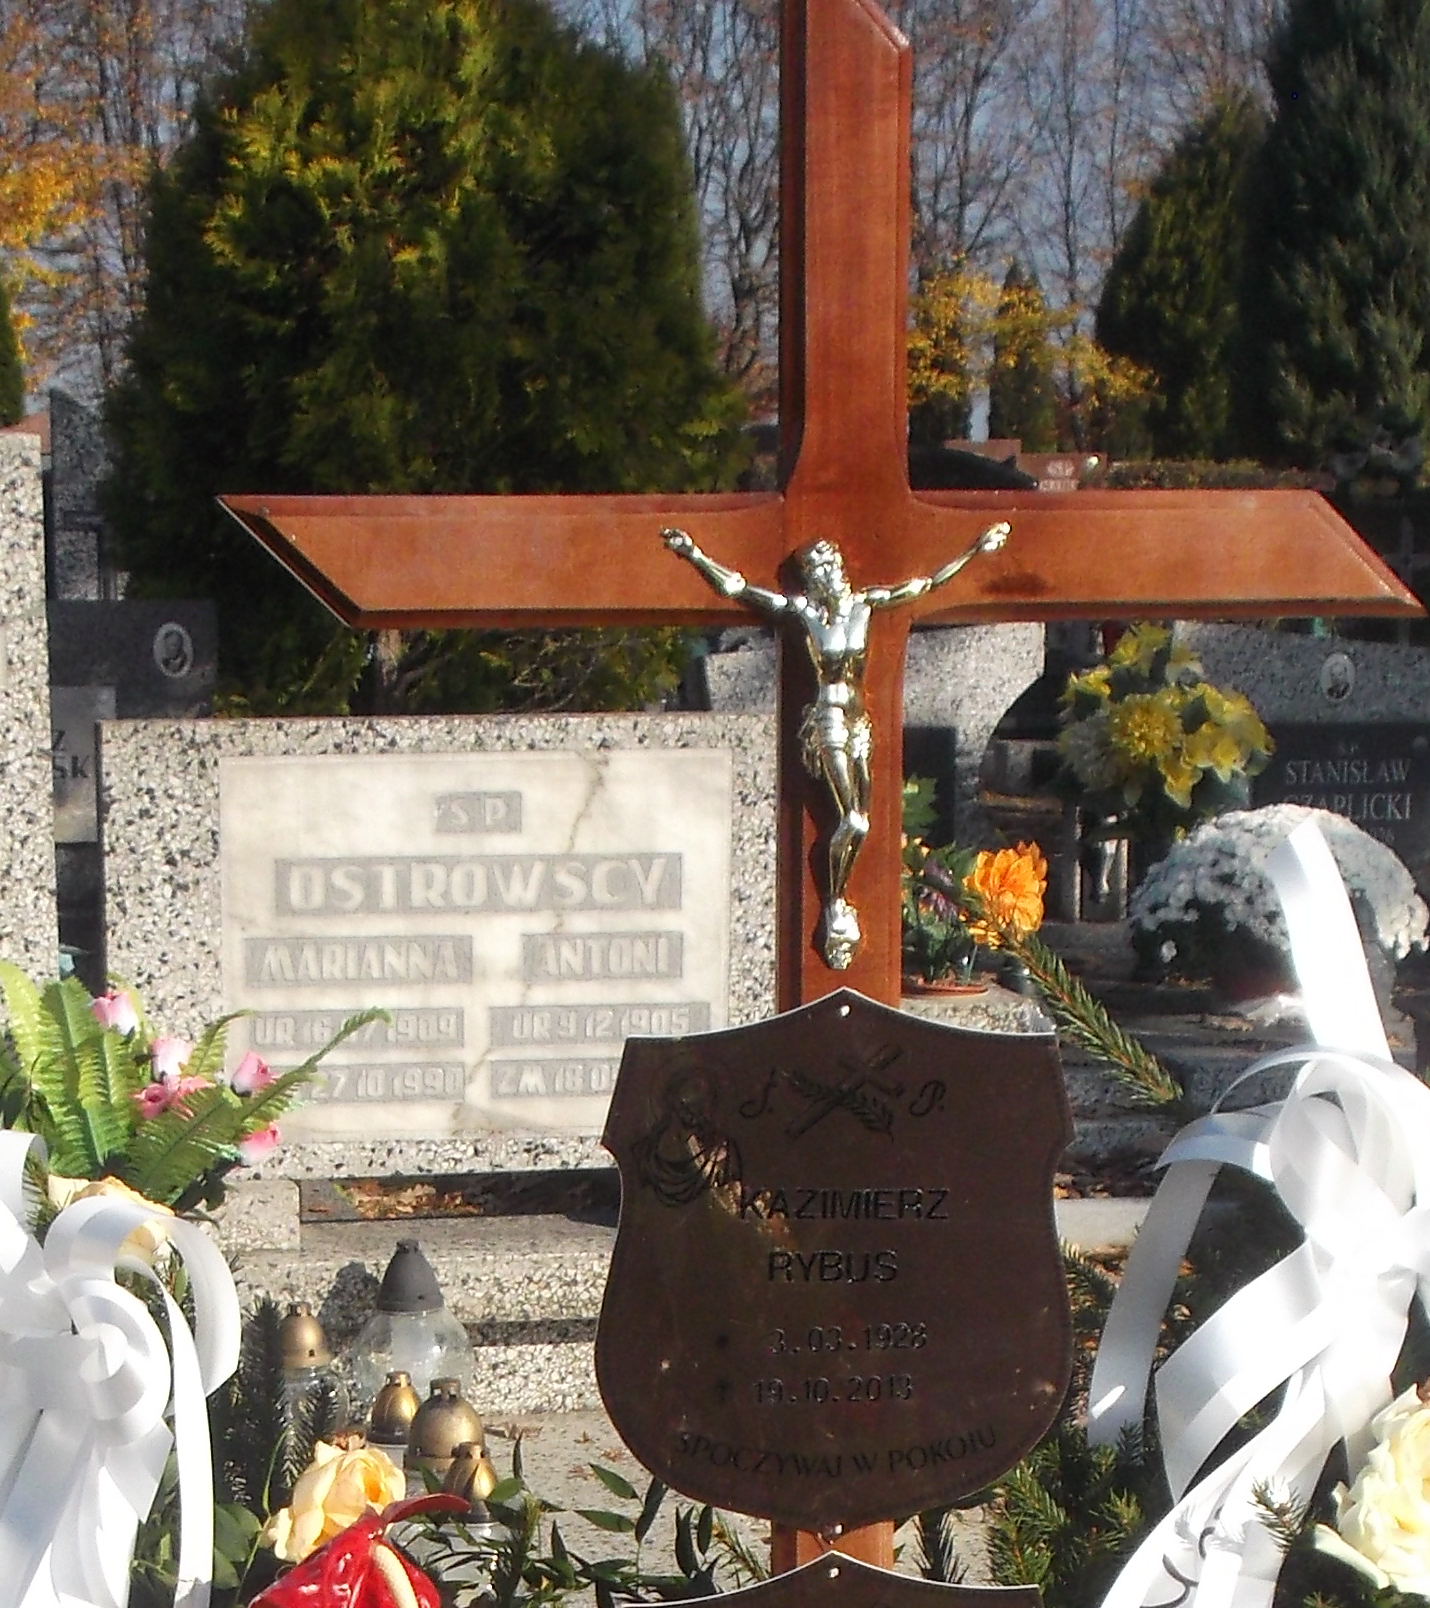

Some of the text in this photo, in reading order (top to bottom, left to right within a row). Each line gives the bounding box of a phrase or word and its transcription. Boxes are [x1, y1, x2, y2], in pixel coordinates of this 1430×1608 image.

[289, 857, 667, 911] OSTROWSCY
[259, 940, 459, 982] MARIANNA
[537, 936, 669, 977] ANTONI
[255, 1016, 295, 1047] UR
[512, 1011, 551, 1040] UR
[619, 1007, 690, 1037] 1905
[496, 1066, 548, 1097] ZM
[739, 1186, 950, 1221] KAZIMIERZ
[768, 1249, 900, 1284] RYBUS
[769, 1321, 928, 1355] 3.03.1928
[753, 1373, 914, 1405] 19.10.2013
[675, 1425, 998, 1479] SPOCZYWAJ W POKOJU
